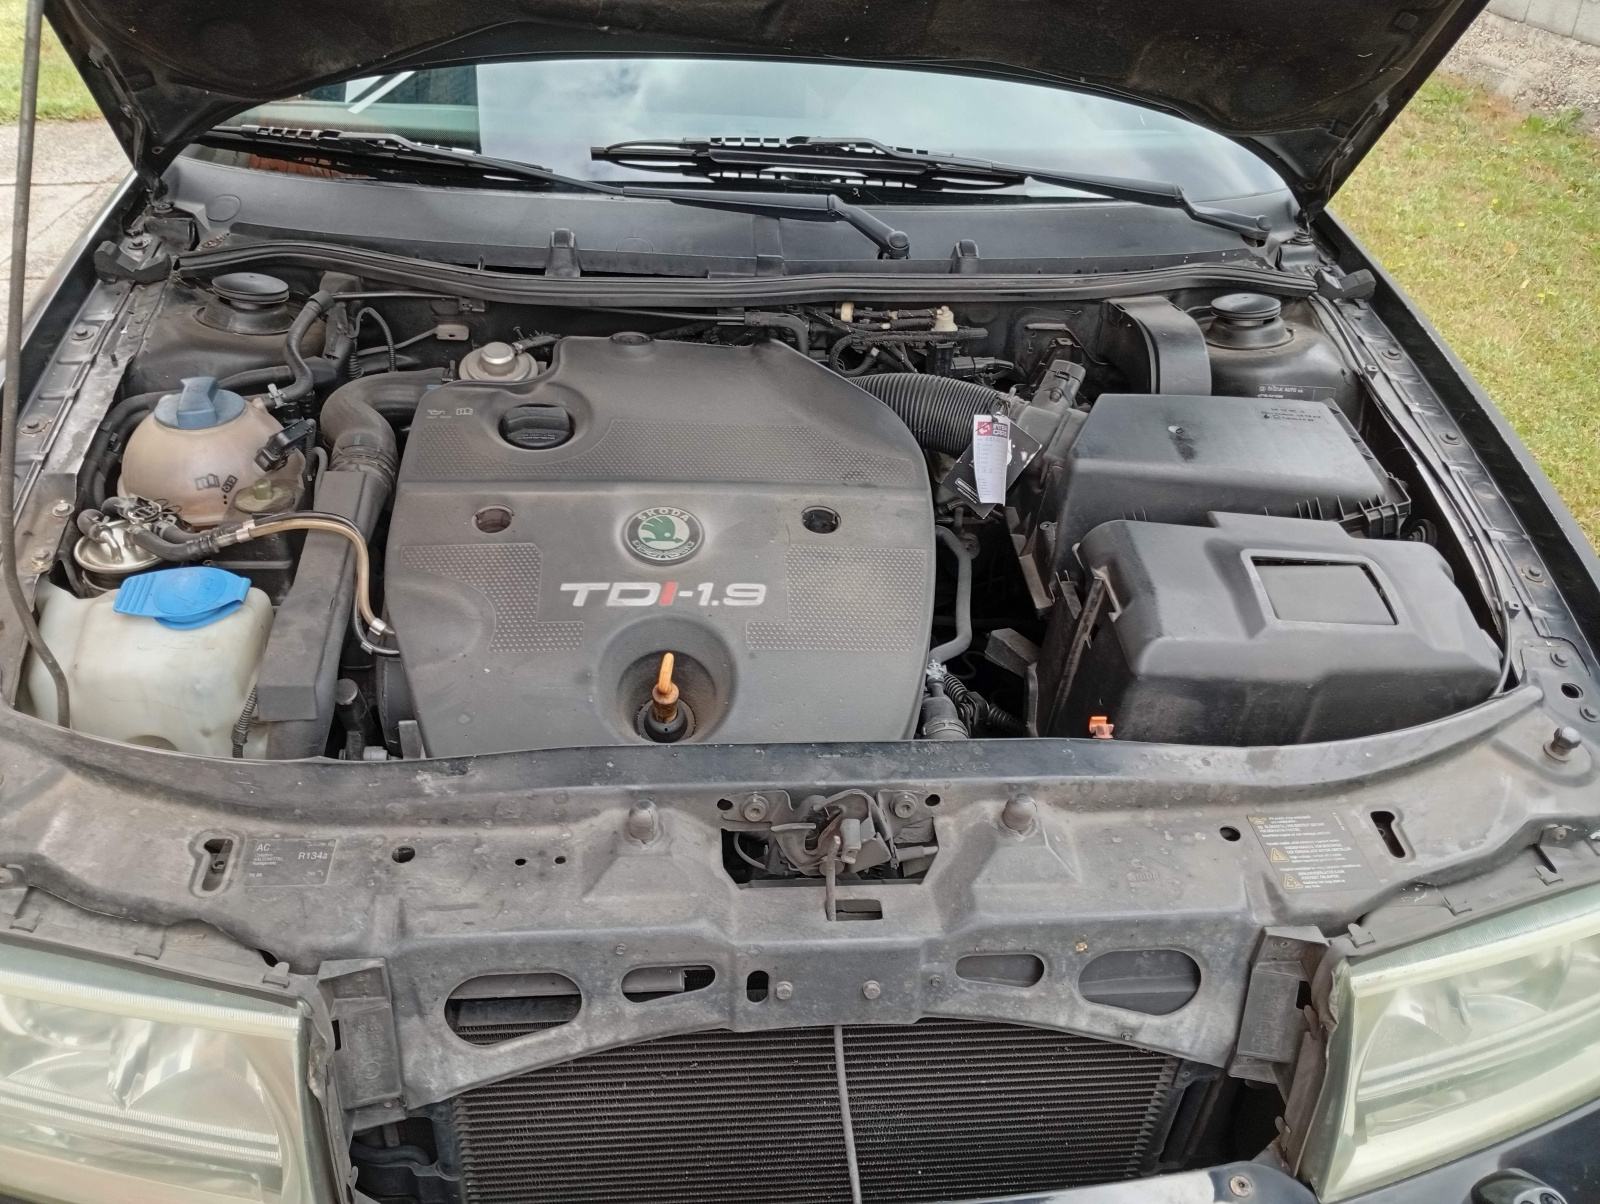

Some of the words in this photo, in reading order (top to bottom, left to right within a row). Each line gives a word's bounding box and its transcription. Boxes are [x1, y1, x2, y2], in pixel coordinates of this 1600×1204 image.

[560, 581, 767, 607] TDI-1.9
[256, 843, 272, 852] AC
[298, 851, 329, 860] R134a
